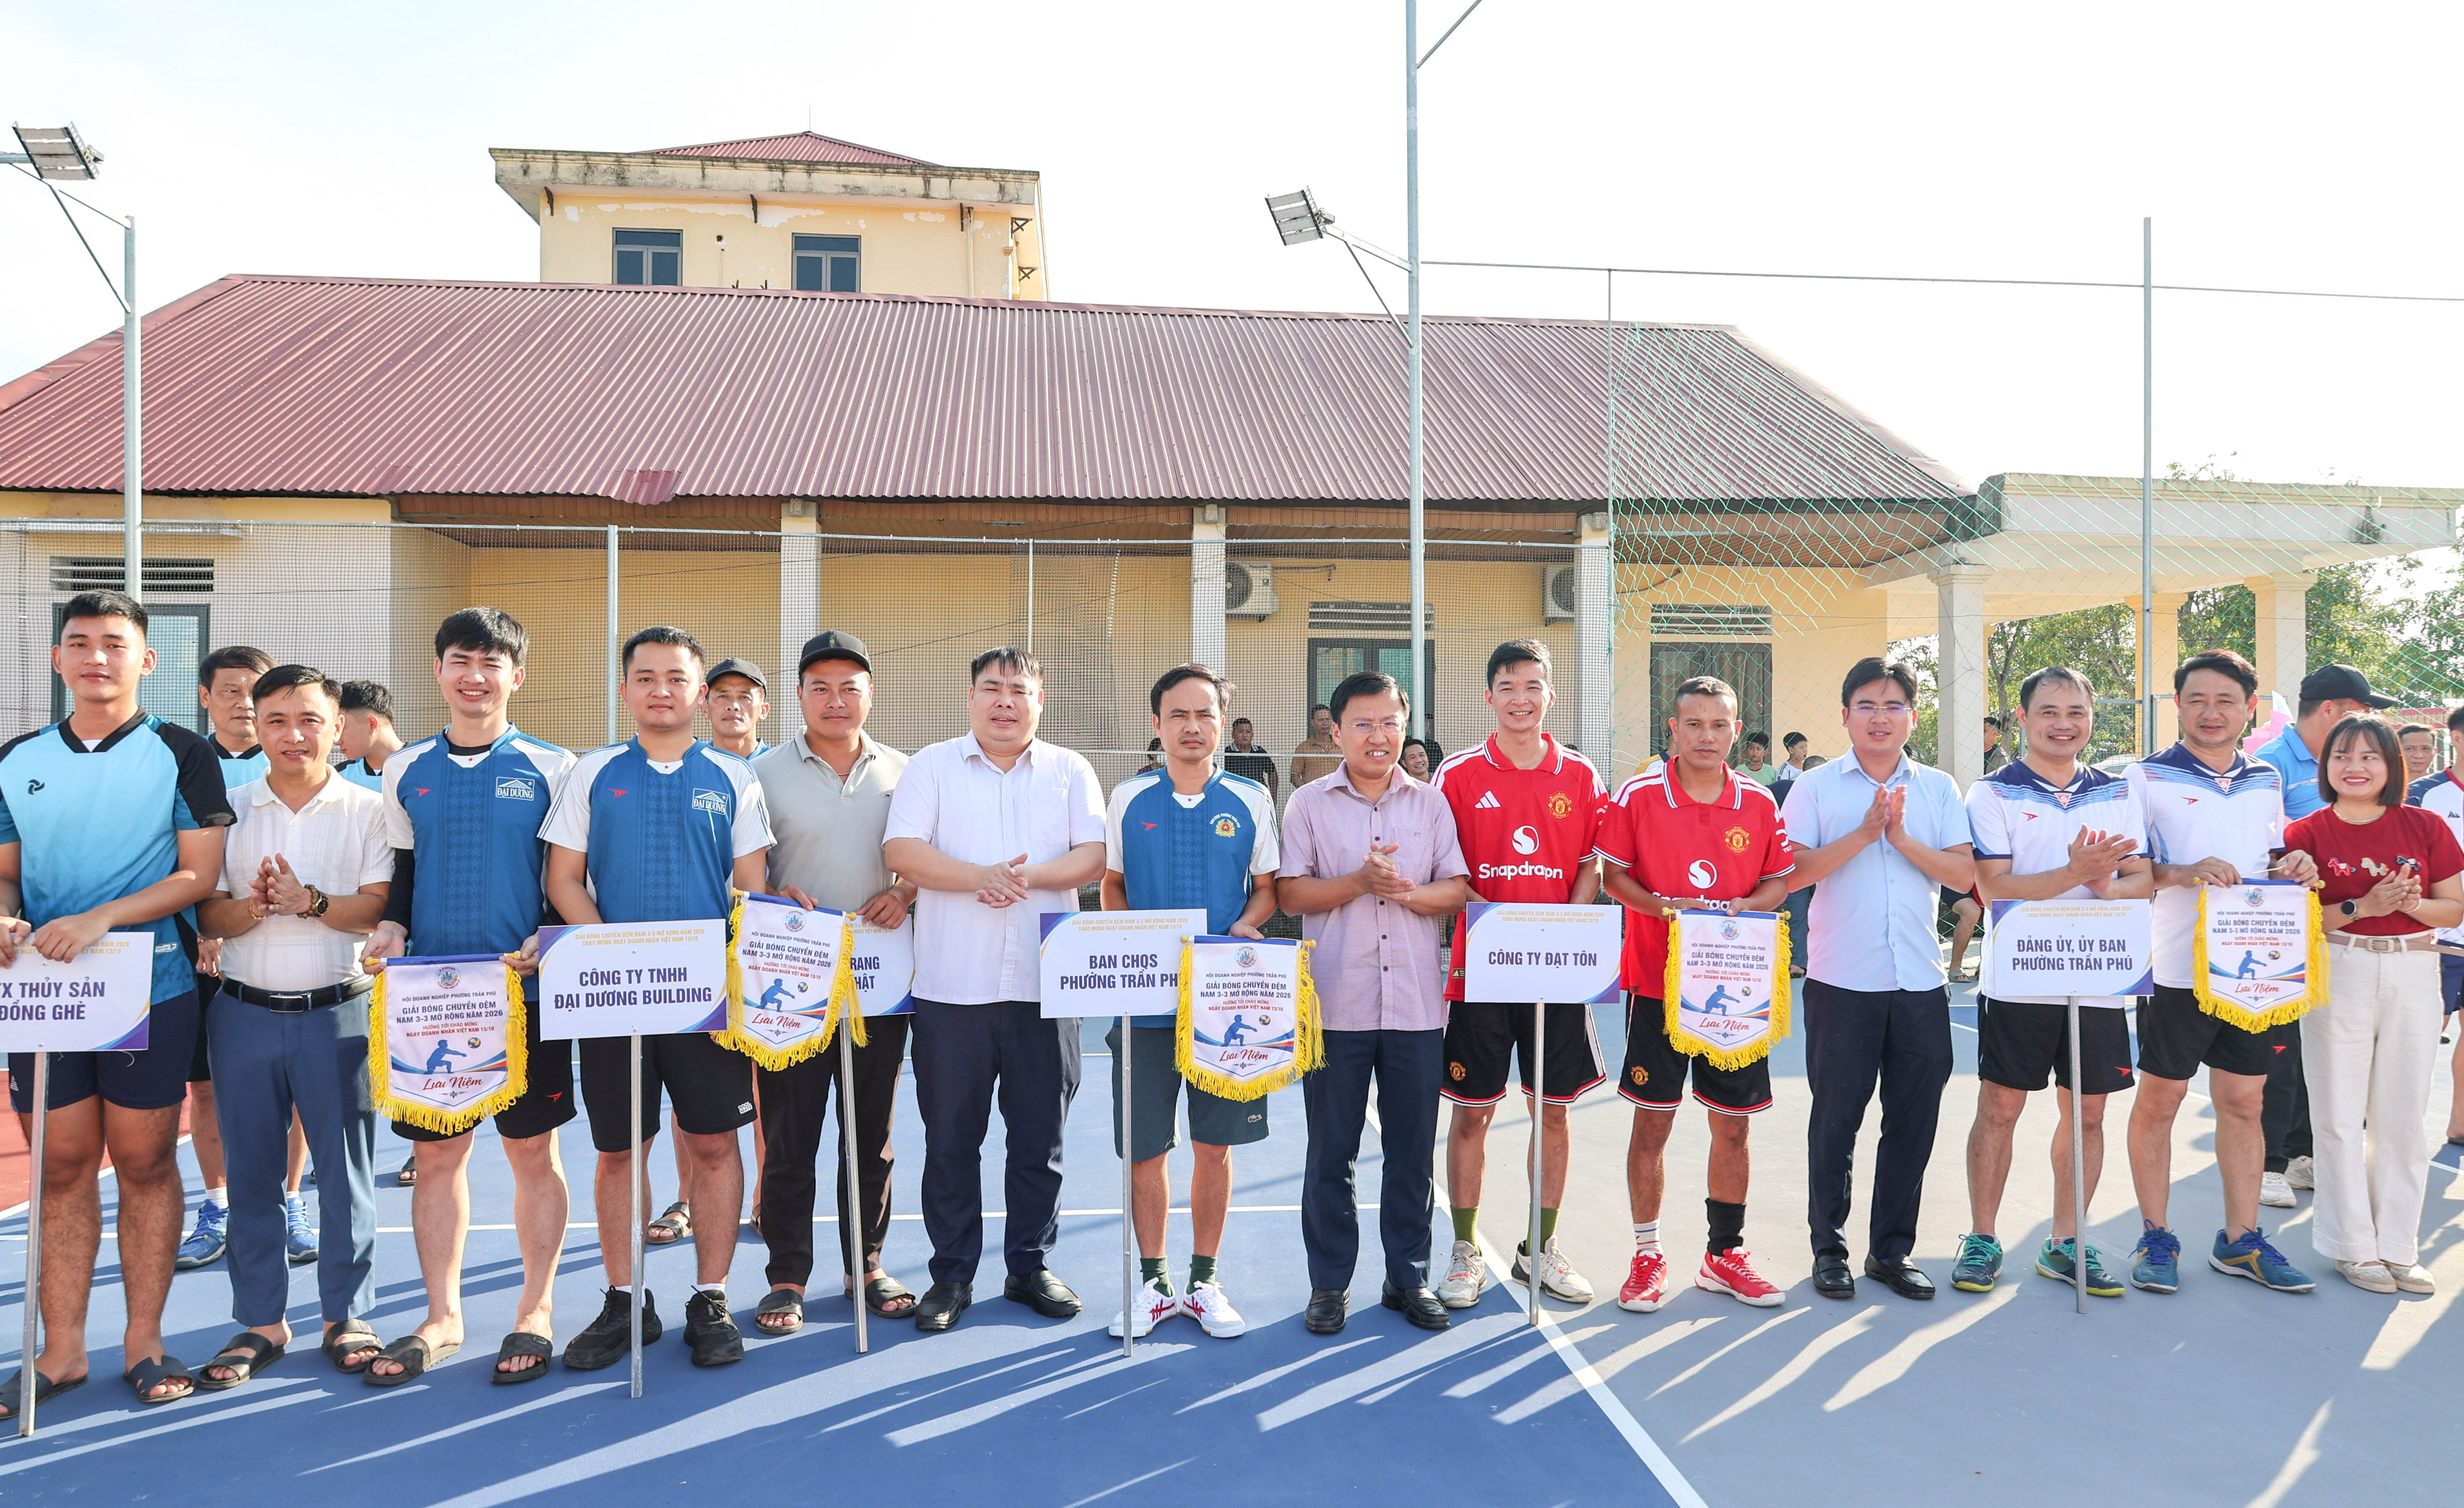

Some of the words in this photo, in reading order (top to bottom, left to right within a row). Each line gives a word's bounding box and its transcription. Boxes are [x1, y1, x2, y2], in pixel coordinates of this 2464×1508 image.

[497, 788, 509, 797] ĐẠI
[510, 788, 533, 799] DƯƠNG
[694, 799, 705, 809] ĐẠI
[706, 800, 725, 813] DƯƠNG
[1478, 860, 1563, 881] Snapdraon
[766, 943, 785, 952] BÓNG
[787, 946, 812, 956] CHUYỀN
[814, 950, 828, 959] ĐỆM
[2017, 935, 2052, 952] ĐẢNG
[2056, 935, 2074, 953] ỦY,
[2078, 935, 2094, 952] ỦY
[2099, 939, 2125, 952] BAN
[850, 956, 880, 970] RANG
[1089, 955, 1117, 969] BAN
[1122, 954, 1158, 969] CHQS
[1488, 949, 1522, 965] CÔNG
[1527, 952, 1541, 965] TY
[1545, 952, 1569, 968] ĐẠT
[1572, 950, 1596, 966] TÔN
[2012, 954, 2064, 970] PHƯỜNG
[2068, 953, 2102, 970] TRẦN
[2107, 955, 2132, 970] PHÚ
[579, 968, 621, 986] CÔNG
[626, 969, 643, 984] TY
[648, 967, 687, 983] TNHH
[854, 973, 875, 992] HẬT
[1060, 972, 1116, 989] PHƯỜNG
[1120, 969, 1155, 988] TRẦN
[1160, 973, 1178, 987] PH
[19, 977, 63, 998] THỦY
[68, 976, 105, 997] SẢN
[1243, 981, 1269, 989] CHUYỀN
[1271, 982, 1286, 991] ĐỆM
[402, 1005, 419, 1014] GIẢI
[422, 1004, 443, 1012] BÓNG
[446, 1002, 476, 1011] CHUYỀN
[478, 1000, 496, 1010] ĐỆM
[554, 993, 579, 1012] ĐẠI
[585, 990, 637, 1007] DƯƠNG
[642, 987, 711, 1004] BUILDING
[0, 999, 45, 1020] ĐỒNG
[52, 1001, 85, 1020] GHÈ
[445, 1012, 464, 1020] RỘNG
[751, 1013, 773, 1024] Lưu
[776, 1016, 801, 1029] Niệm
[1219, 1051, 1238, 1061] Lưu
[1240, 1051, 1268, 1061] Niệm
[422, 1079, 446, 1090] Lưu
[449, 1077, 483, 1088] Niệm
